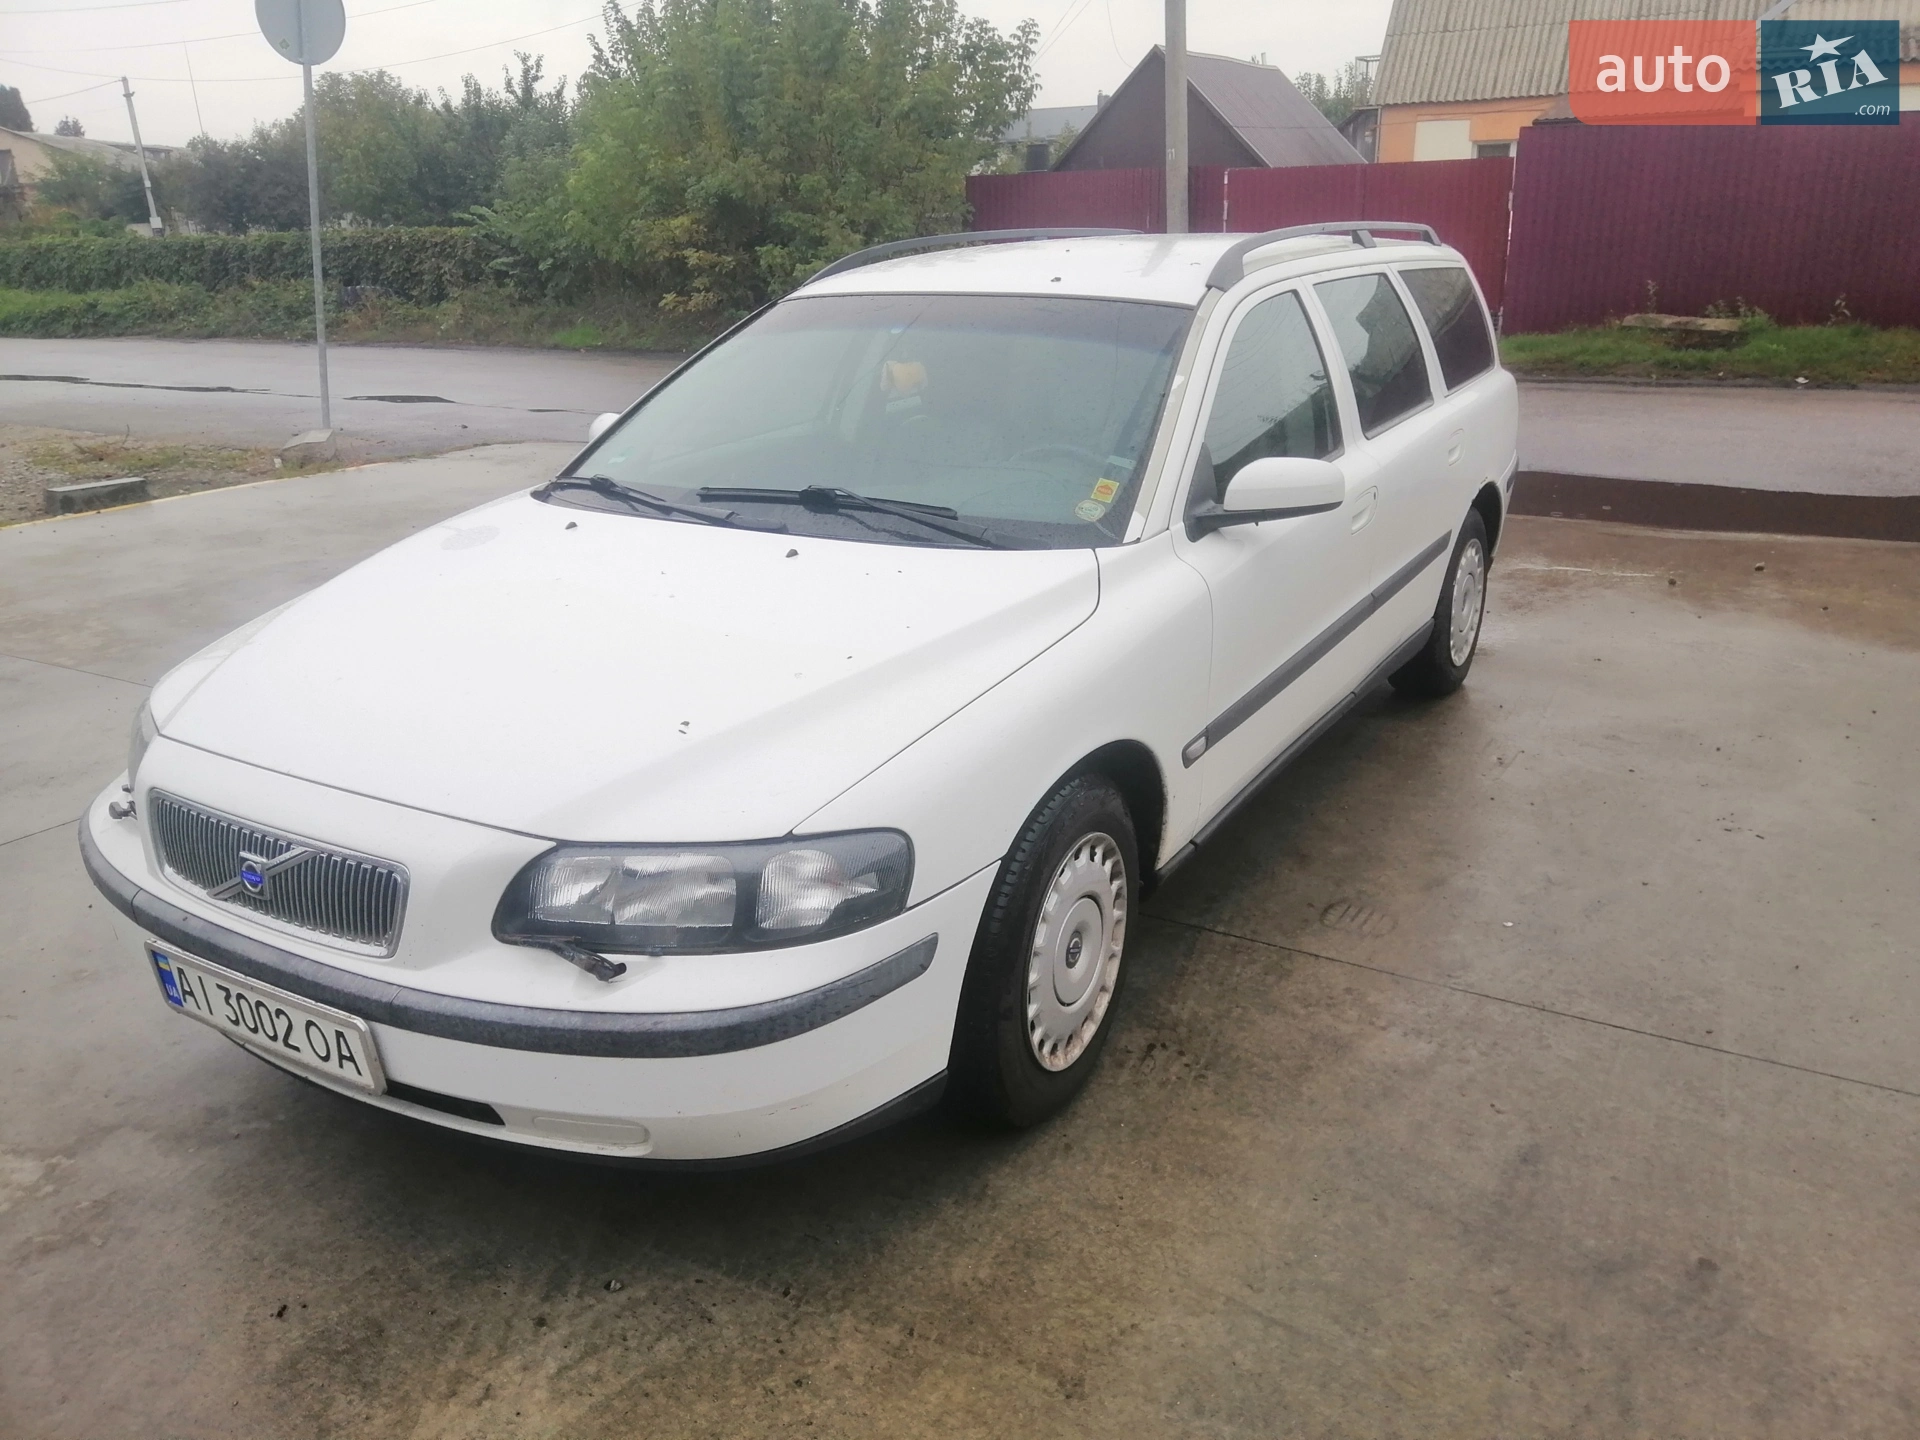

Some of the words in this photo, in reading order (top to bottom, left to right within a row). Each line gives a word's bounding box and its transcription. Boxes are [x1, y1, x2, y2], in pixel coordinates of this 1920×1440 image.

[165, 983, 180, 1000] UA
[177, 967, 214, 1016] AI
[216, 984, 302, 1053] 3002
[304, 1019, 362, 1076] OA
